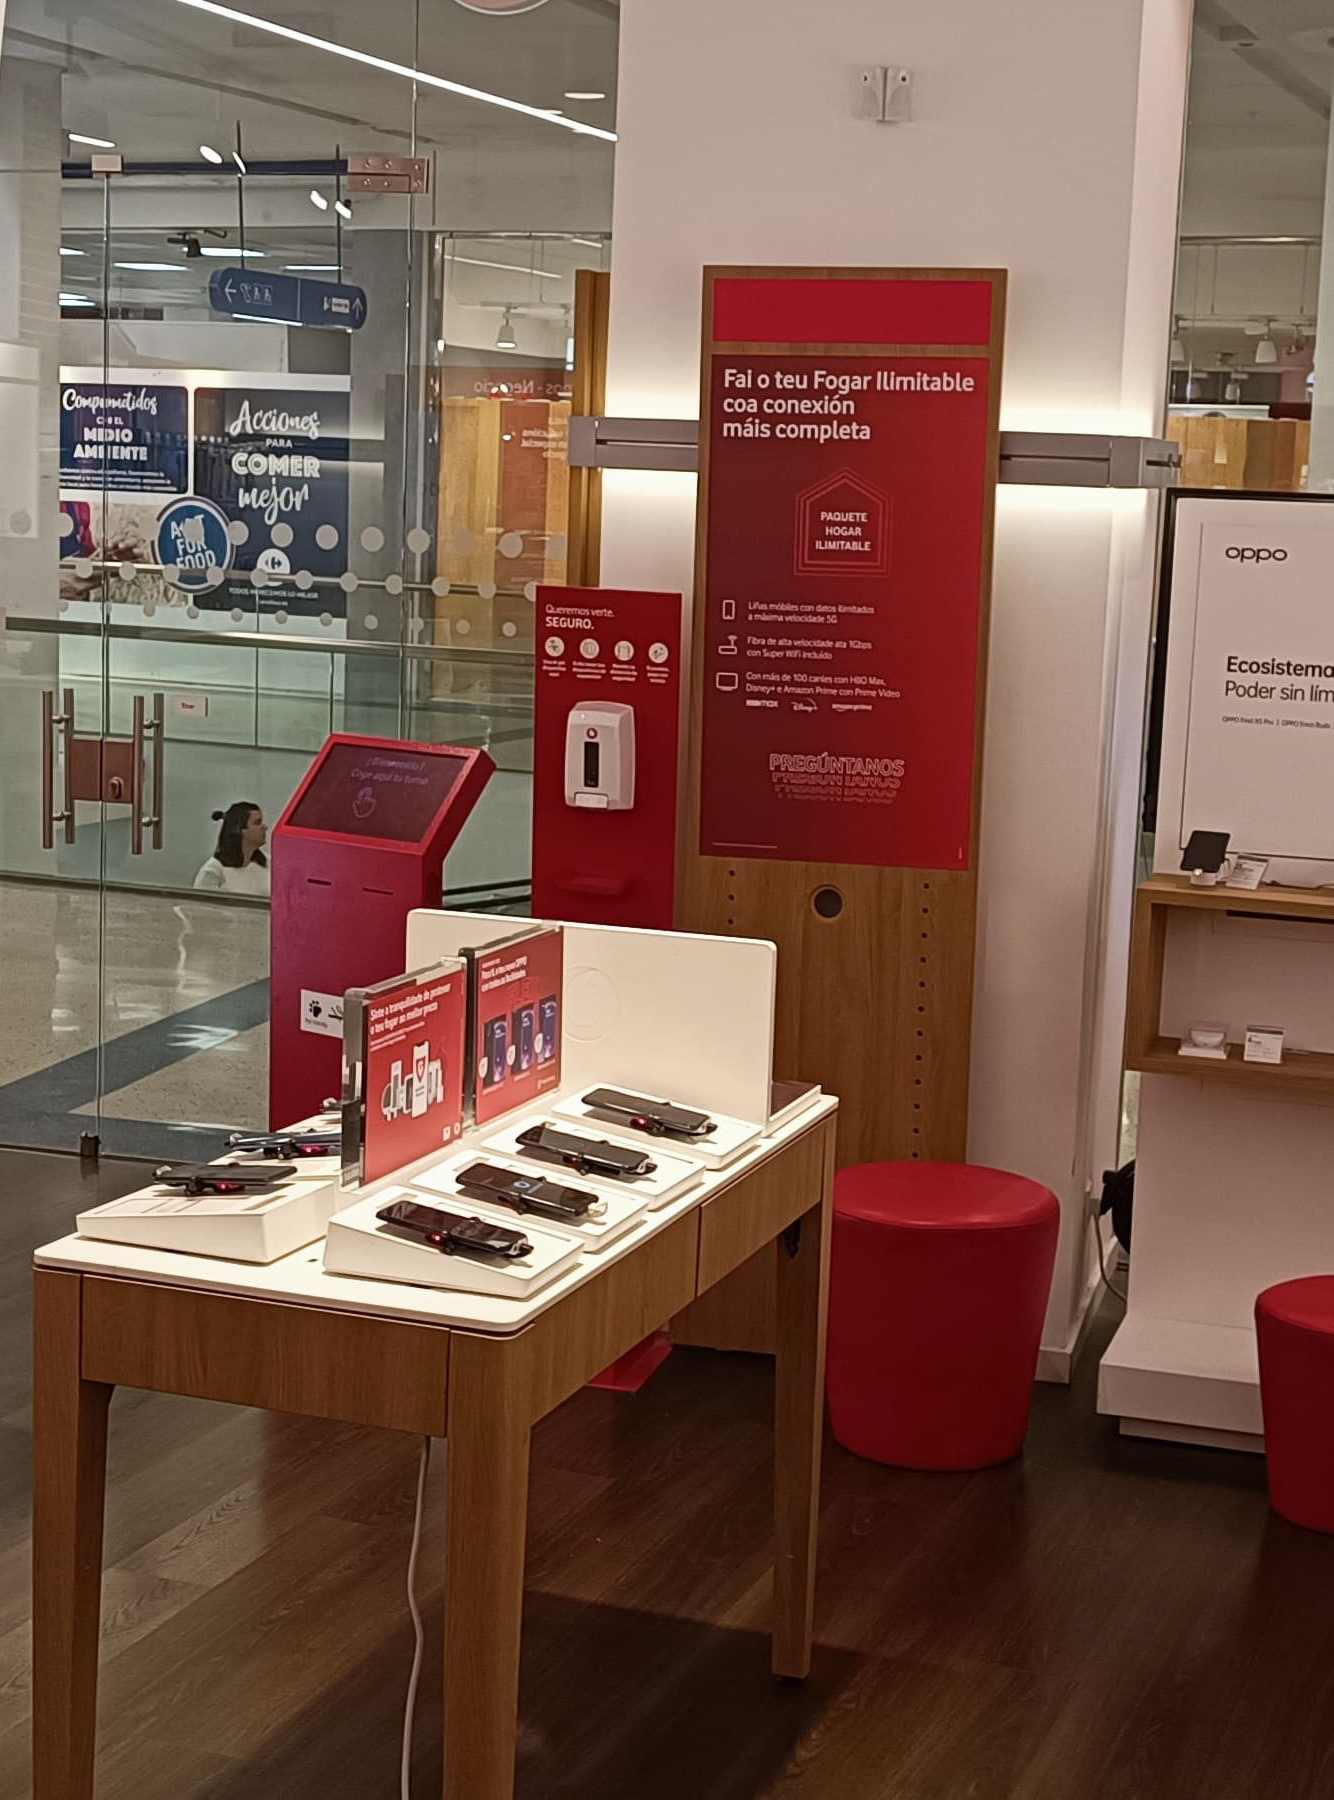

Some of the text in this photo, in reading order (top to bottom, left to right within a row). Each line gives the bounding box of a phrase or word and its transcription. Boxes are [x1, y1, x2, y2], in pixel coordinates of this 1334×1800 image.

[723, 368, 975, 395] Fai o teu Fogar Ilimitable
[723, 394, 855, 416] coa conexión
[228, 400, 321, 439] Acciones
[723, 418, 871, 444] máis completa
[265, 437, 294, 449] PARA
[230, 453, 321, 479] COMER
[237, 477, 310, 525] mejor
[820, 511, 868, 522] PAQUETE
[825, 526, 862, 537] HOGAR
[815, 540, 871, 552] ILIMITABLE
[1225, 546, 1289, 564] oppo
[545, 604, 590, 616] Queremos
[748, 601, 768, 611] Liñas
[800, 604, 815, 612] con
[816, 603, 836, 613] datos
[545, 616, 595, 630] SEGURO.
[754, 613, 838, 624] máxima velocidade 5G
[747, 636, 765, 646] Fibra
[767, 637, 777, 646] de
[778, 638, 792, 646] alta
[793, 638, 834, 648] velocidade
[835, 640, 847, 649] ata
[762, 648, 784, 659] Super
[785, 649, 802, 659] WiFi
[745, 671, 761, 681] Con
[762, 672, 780, 682] máis
[781, 673, 791, 682] de
[793, 673, 808, 682] 100
[834, 676, 848, 684] con
[850, 675, 867, 685] HBO
[783, 684, 815, 695] Amazon
[816, 686, 837, 696] Prime
[838, 688, 854, 697] con
[854, 687, 877, 698] Prime
[877, 688, 901, 698] Video
[1224, 680, 1277, 700] Poder
[1280, 683, 1306, 702] sin
[769, 752, 905, 777] PREGÚNTANOS
